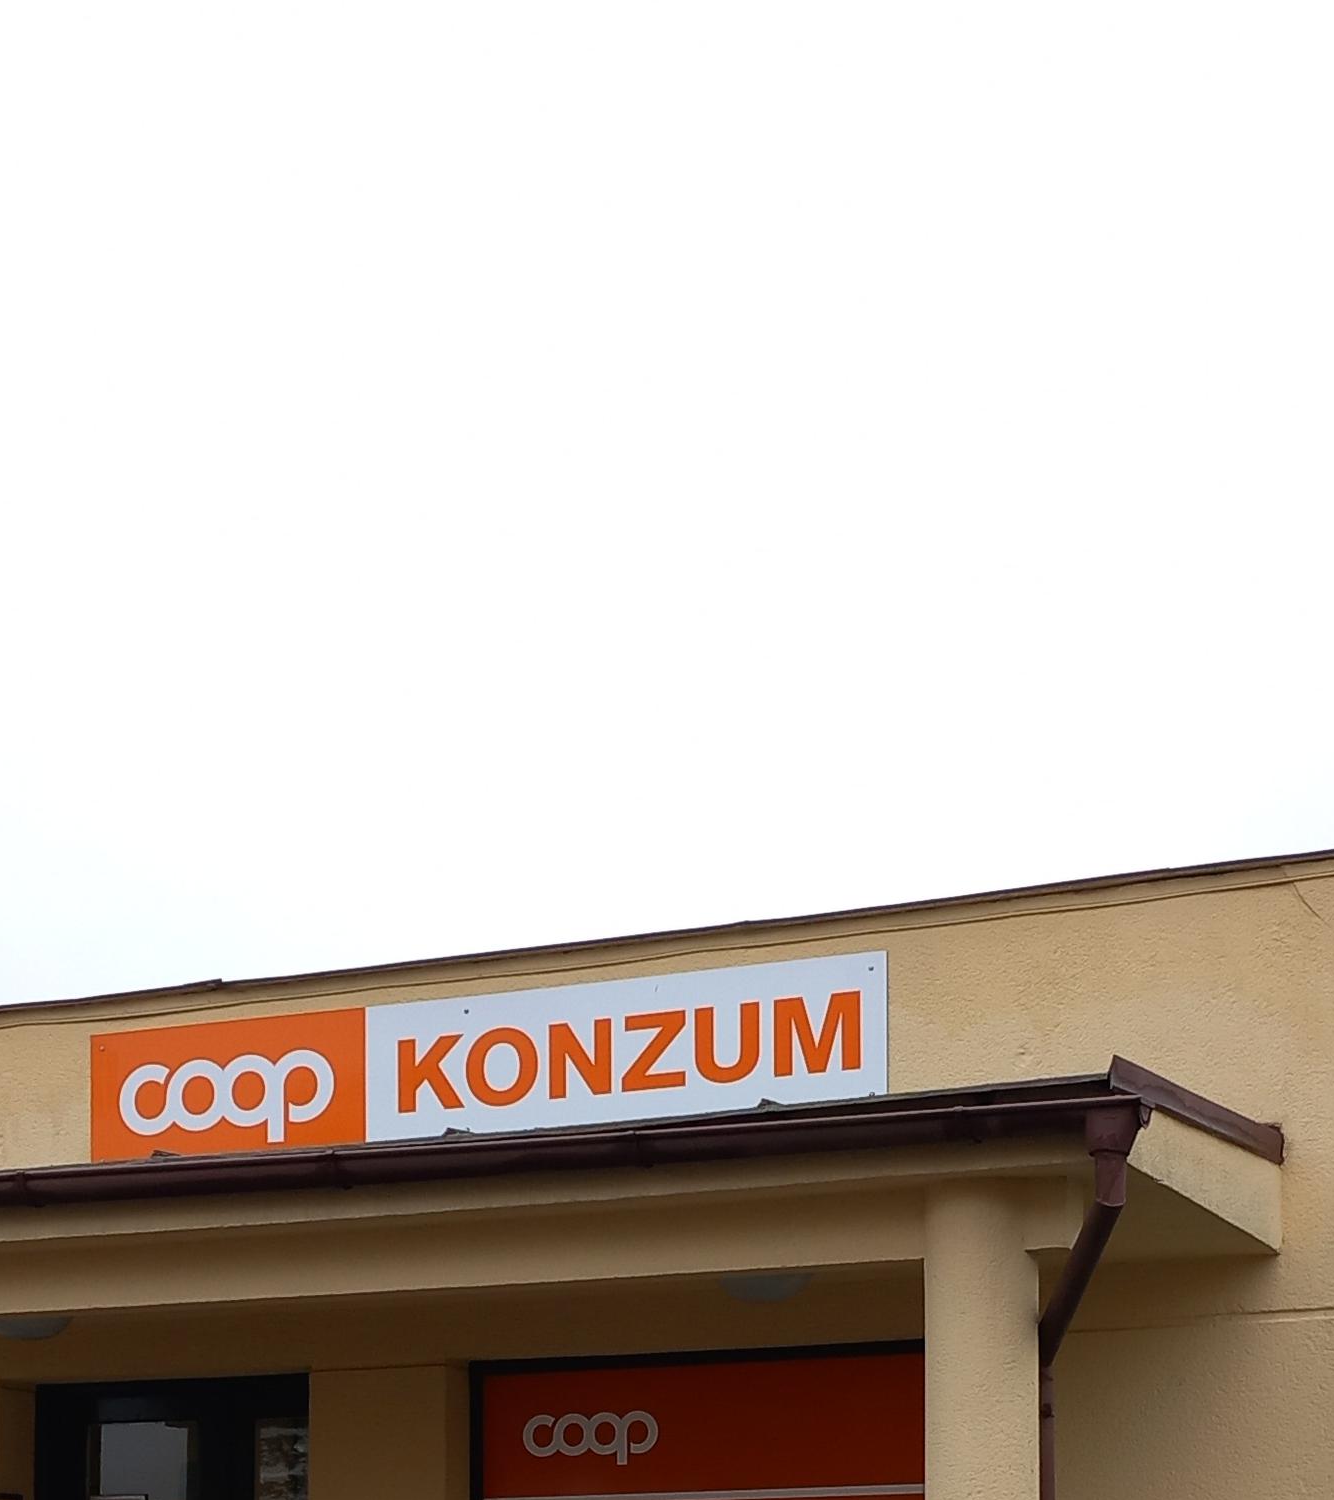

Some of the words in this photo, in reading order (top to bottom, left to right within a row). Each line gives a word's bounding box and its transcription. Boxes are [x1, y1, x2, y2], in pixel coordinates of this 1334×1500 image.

[119, 1048, 335, 1143] coop
[397, 990, 862, 1114] KONZUM
[522, 1410, 659, 1466] coop
